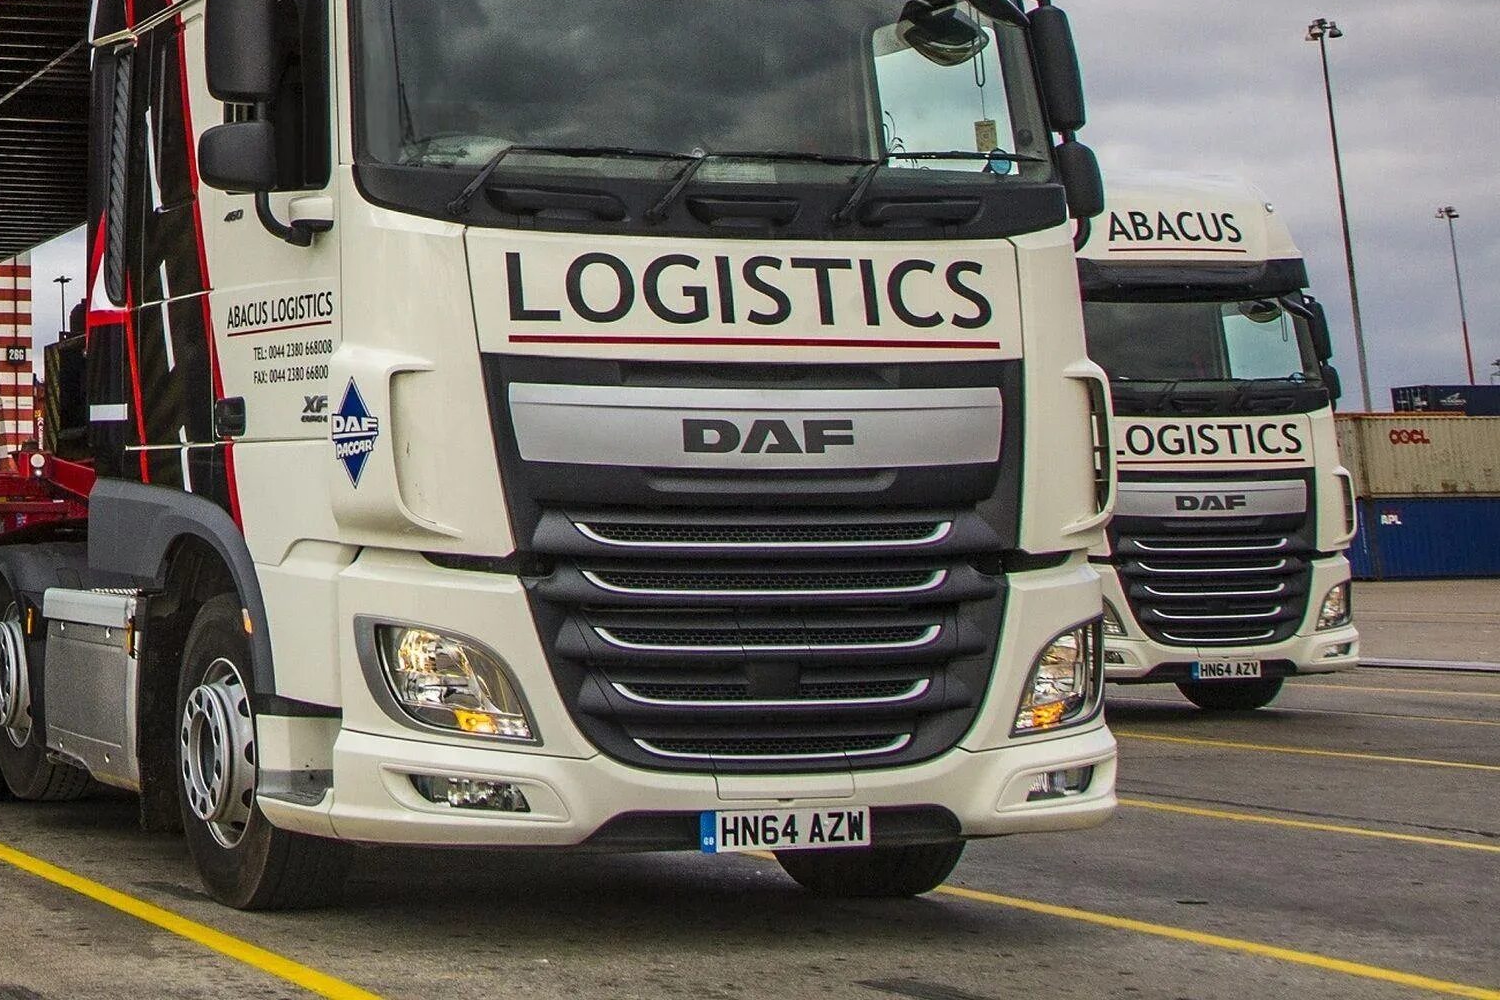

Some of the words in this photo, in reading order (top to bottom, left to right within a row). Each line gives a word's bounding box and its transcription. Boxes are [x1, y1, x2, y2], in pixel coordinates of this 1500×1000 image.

[1108, 211, 1242, 243] ABACUS
[505, 252, 993, 329] LOGISTICS
[227, 300, 268, 330] ABACUS
[271, 291, 333, 323] LOGISTICS
[253, 346, 268, 361] TEL:
[268, 345, 285, 359] 0044
[287, 342, 304, 357] 2380
[254, 369, 268, 385] FAX:
[269, 368, 285, 383] 0044
[287, 366, 304, 381] 2380
[302, 395, 328, 413] XF
[332, 416, 377, 433] DAF
[682, 418, 854, 453] DAF
[1389, 429, 1430, 444] OOCL
[336, 440, 372, 458] PACCAR
[1175, 495, 1247, 511] DAF
[1381, 514, 1402, 525] APL
[1201, 663, 1232, 677] HN64
[722, 814, 799, 847] HN64
[809, 811, 864, 843] AZW
